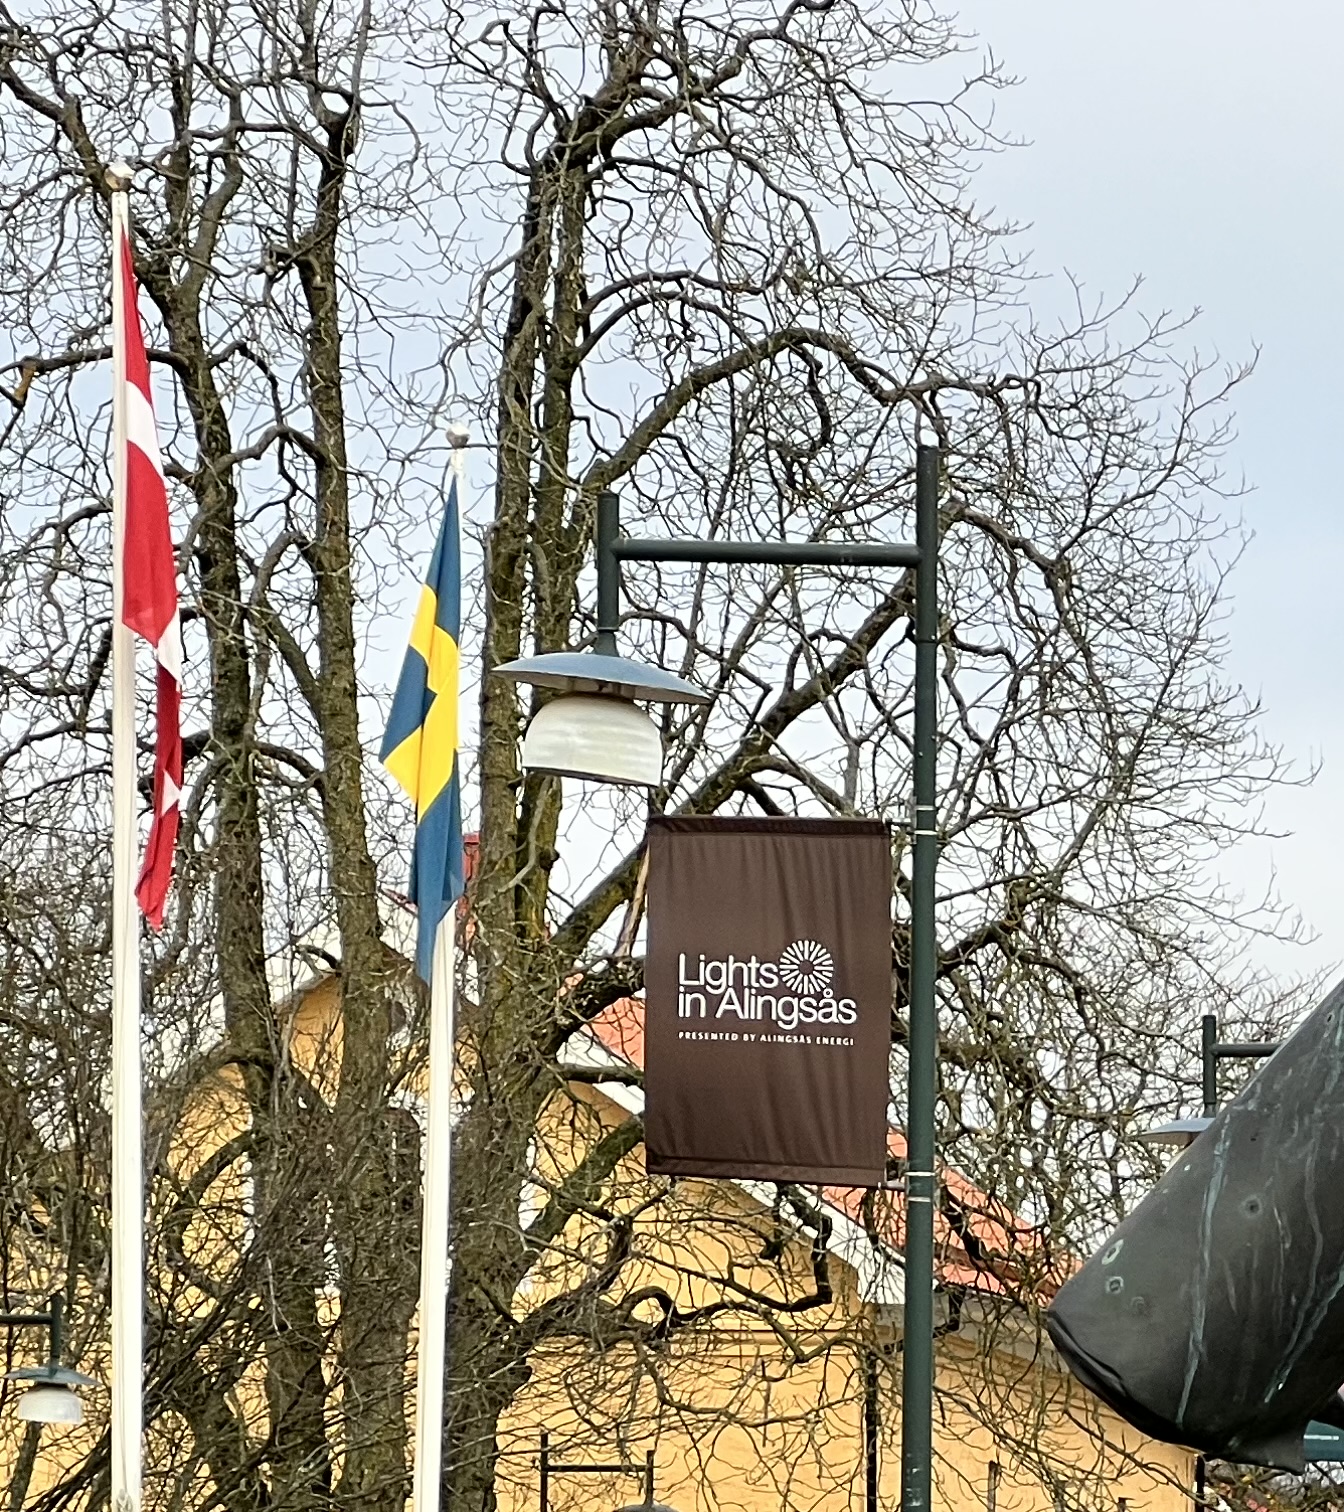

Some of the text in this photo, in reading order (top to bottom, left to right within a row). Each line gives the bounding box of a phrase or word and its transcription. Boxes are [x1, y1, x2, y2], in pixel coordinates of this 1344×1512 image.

[678, 953, 779, 994] Lights
[678, 986, 857, 1030] in Alingsås
[678, 1031, 739, 1042] PRESENTED
[743, 1033, 756, 1042] BY
[816, 1036, 854, 1046] ENERGI
